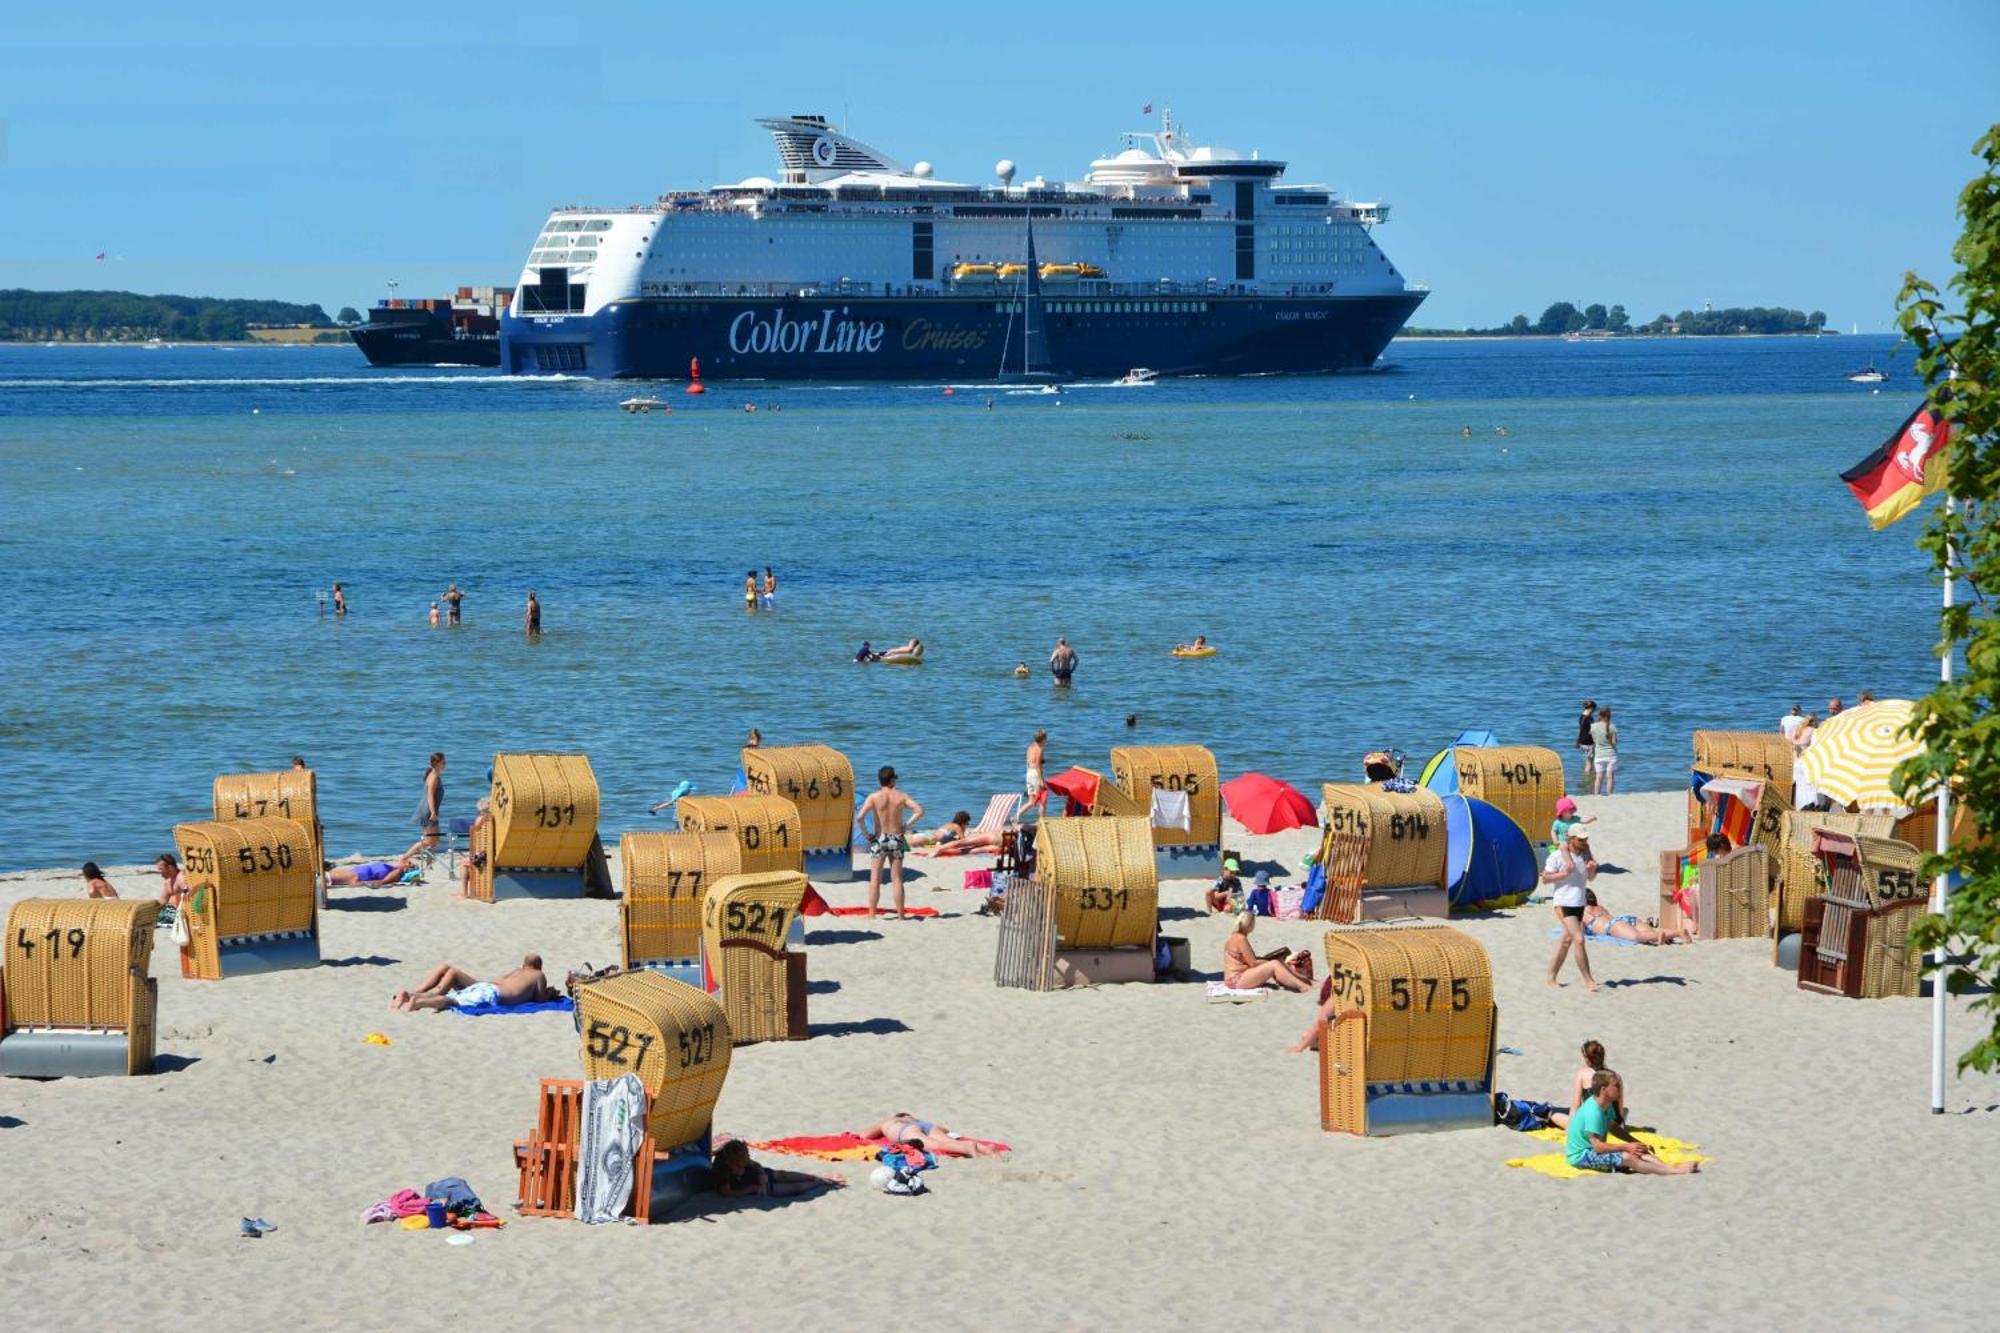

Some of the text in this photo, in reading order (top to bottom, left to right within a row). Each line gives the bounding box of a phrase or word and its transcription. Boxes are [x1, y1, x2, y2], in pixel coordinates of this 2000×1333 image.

[902, 317, 992, 350] Cruises
[787, 776, 843, 800] 463
[1501, 763, 1542, 785] 404
[535, 803, 576, 828] 131
[1332, 805, 1368, 835] 514
[714, 823, 789, 850] 01
[185, 845, 214, 874] 530
[238, 843, 293, 874] 530
[668, 870, 703, 898] 77
[1878, 870, 1930, 900] 55
[1080, 887, 1128, 912] 531
[727, 901, 786, 938] 521
[17, 928, 87, 960] 419
[1333, 963, 1365, 1008] 575
[1390, 977, 1471, 1012] 575
[587, 1017, 655, 1072] 527
[679, 1023, 715, 1069] 527
